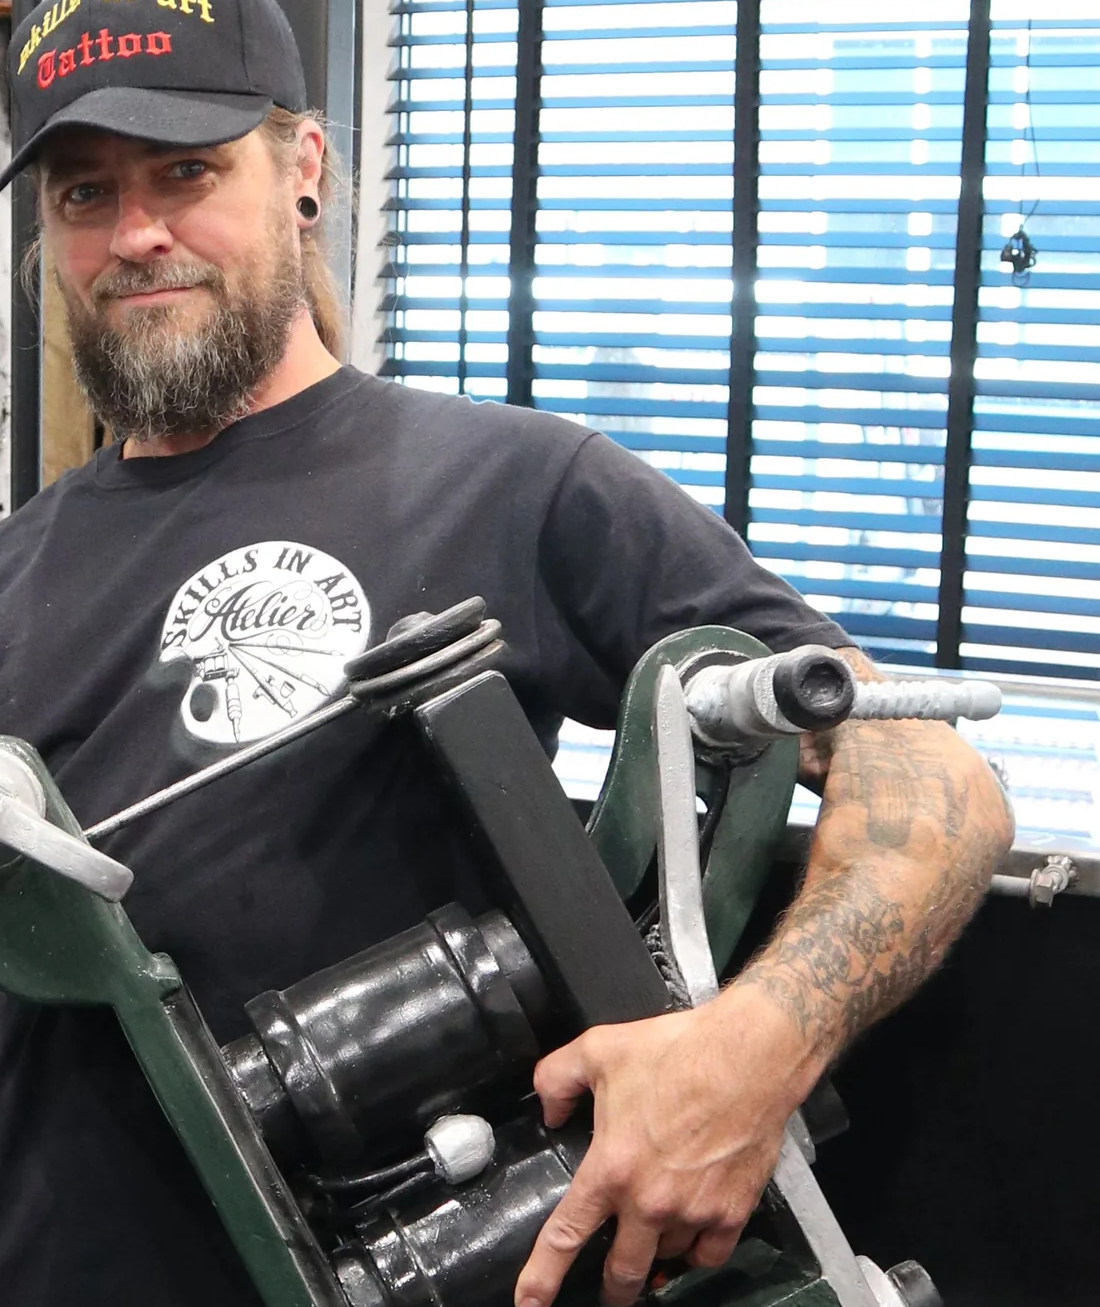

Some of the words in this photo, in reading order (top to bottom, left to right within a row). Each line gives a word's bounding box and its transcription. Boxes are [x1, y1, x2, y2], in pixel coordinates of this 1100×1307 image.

[37, 28, 173, 89] Tattoo
[162, 548, 259, 651] SKILLS
[273, 547, 316, 574] IN
[314, 572, 362, 634] ART
[188, 580, 328, 642] Atelier
